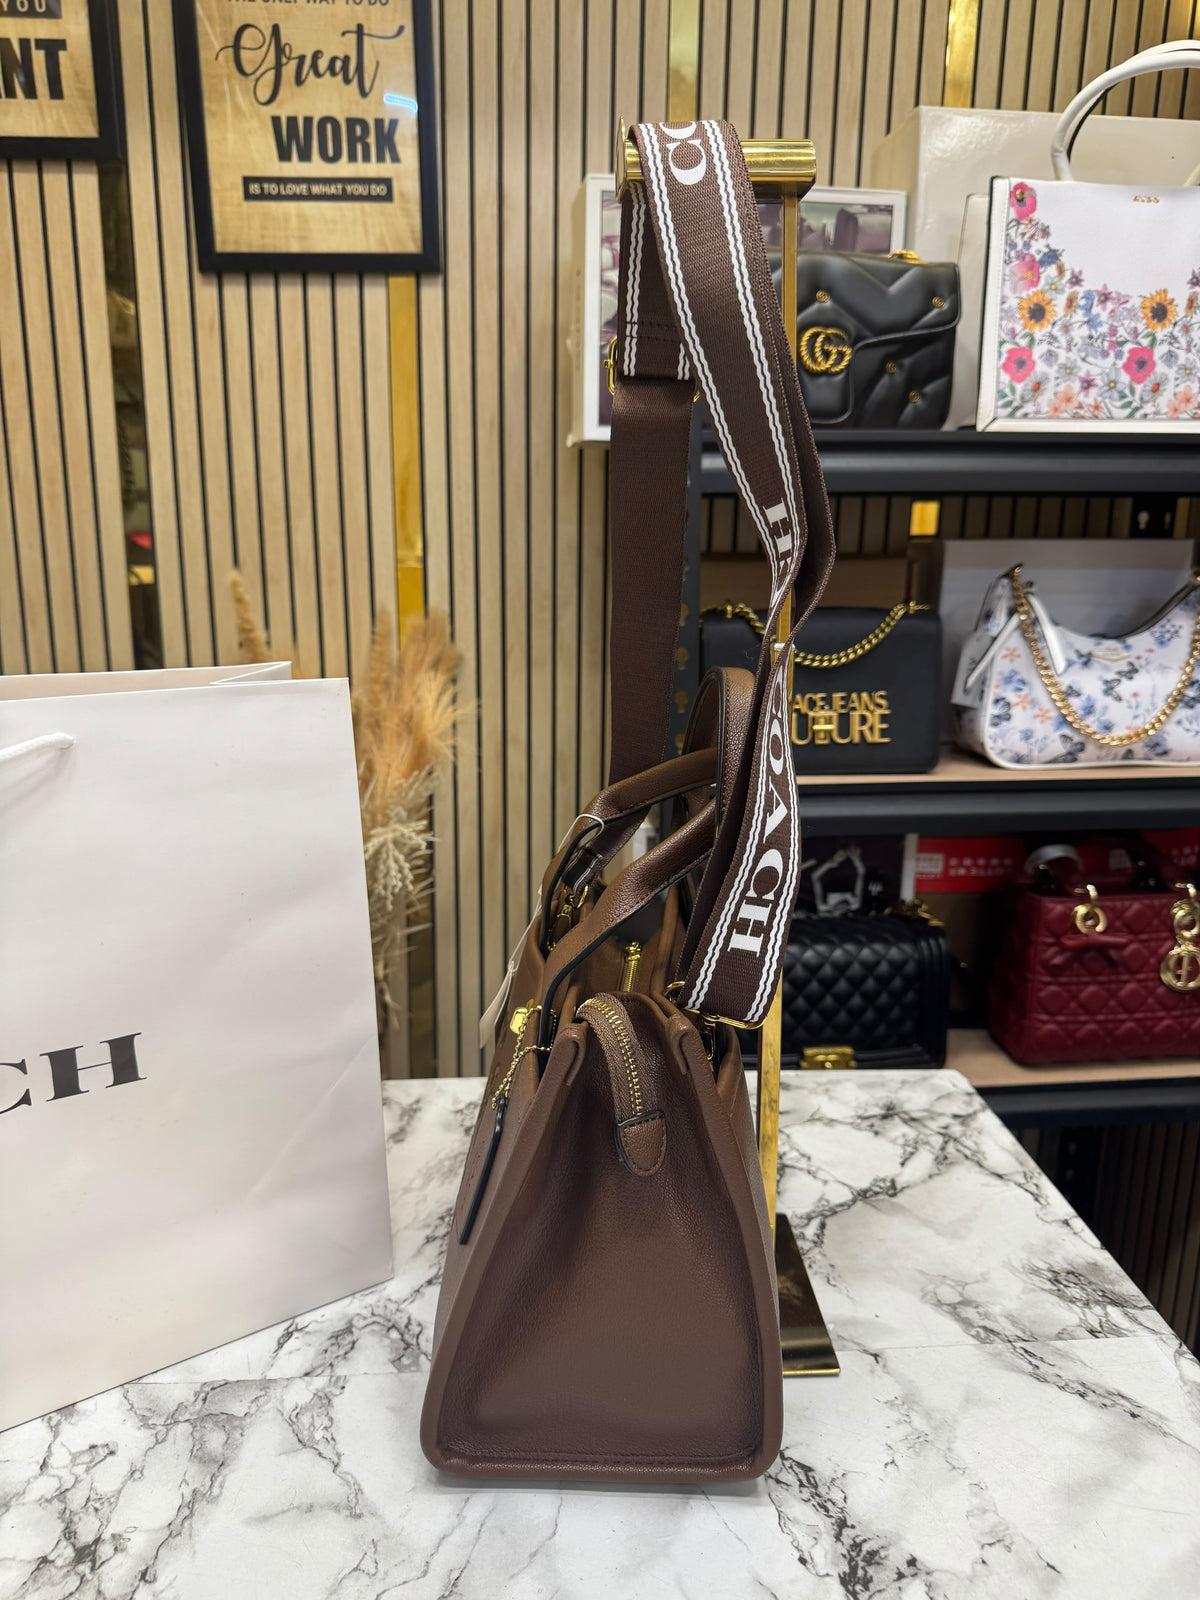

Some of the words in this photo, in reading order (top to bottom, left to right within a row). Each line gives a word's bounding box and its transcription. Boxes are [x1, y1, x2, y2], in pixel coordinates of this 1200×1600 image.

[0, 0, 46, 12] YOU
[215, 23, 405, 106] Great
[271, 115, 401, 164] WORK
[249, 183, 261, 195] IS
[263, 183, 278, 195] TO
[279, 183, 308, 195] LOVE
[309, 183, 344, 196] WHAT
[345, 183, 369, 196] YOU
[370, 183, 388, 196] DO
[727, 664, 789, 958] COACH
